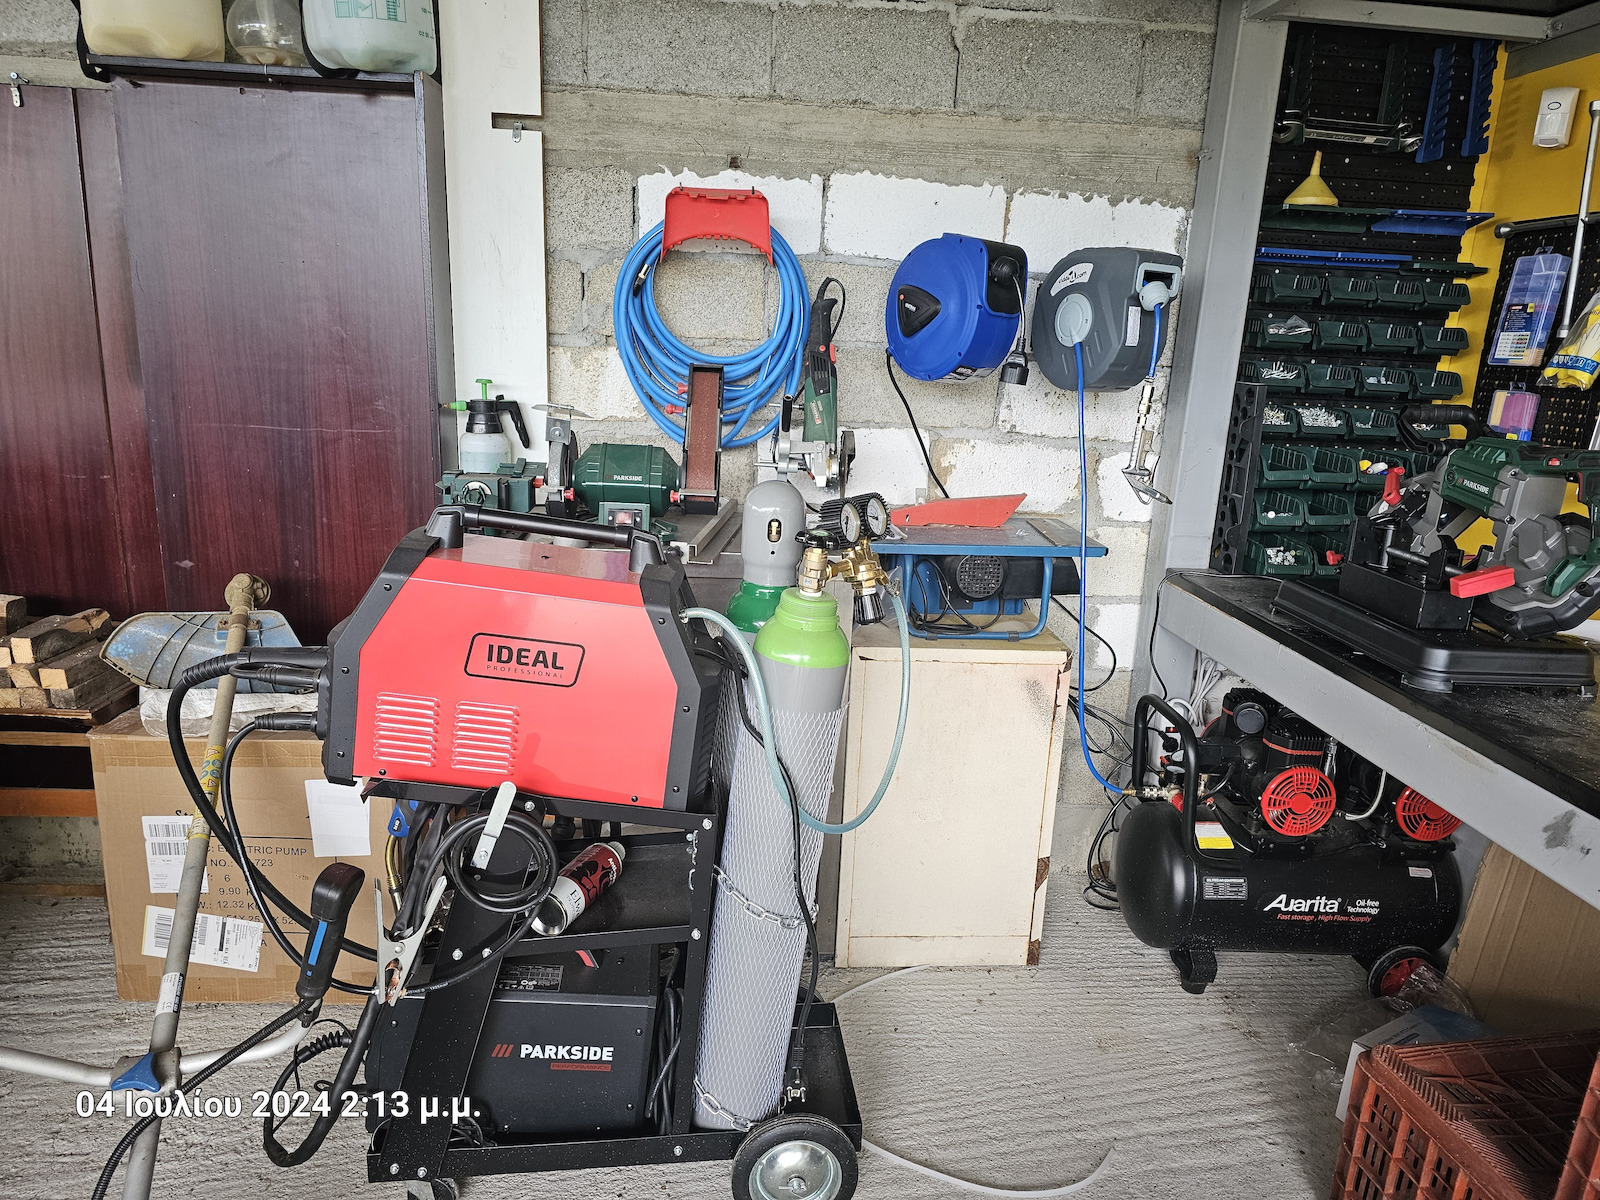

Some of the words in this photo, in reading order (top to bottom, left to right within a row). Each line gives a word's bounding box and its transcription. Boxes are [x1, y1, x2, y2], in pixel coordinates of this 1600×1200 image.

[613, 474, 643, 482] PARKSIDE
[1462, 479, 1490, 495] PARKSIDE
[487, 643, 564, 671] IDEAL
[486, 664, 563, 679] PROFESSIONAL
[275, 847, 307, 856] PUMP
[224, 874, 231, 883] 6
[218, 886, 241, 896] 9.90
[217, 900, 245, 909] 12.32
[1355, 899, 1380, 907] Oil-free
[1346, 906, 1380, 915] Technology
[1317, 914, 1333, 923] High
[1349, 915, 1372, 923] Supply
[520, 1044, 614, 1061] PARKSIDE
[551, 1063, 611, 1071] PERFORMANCE
